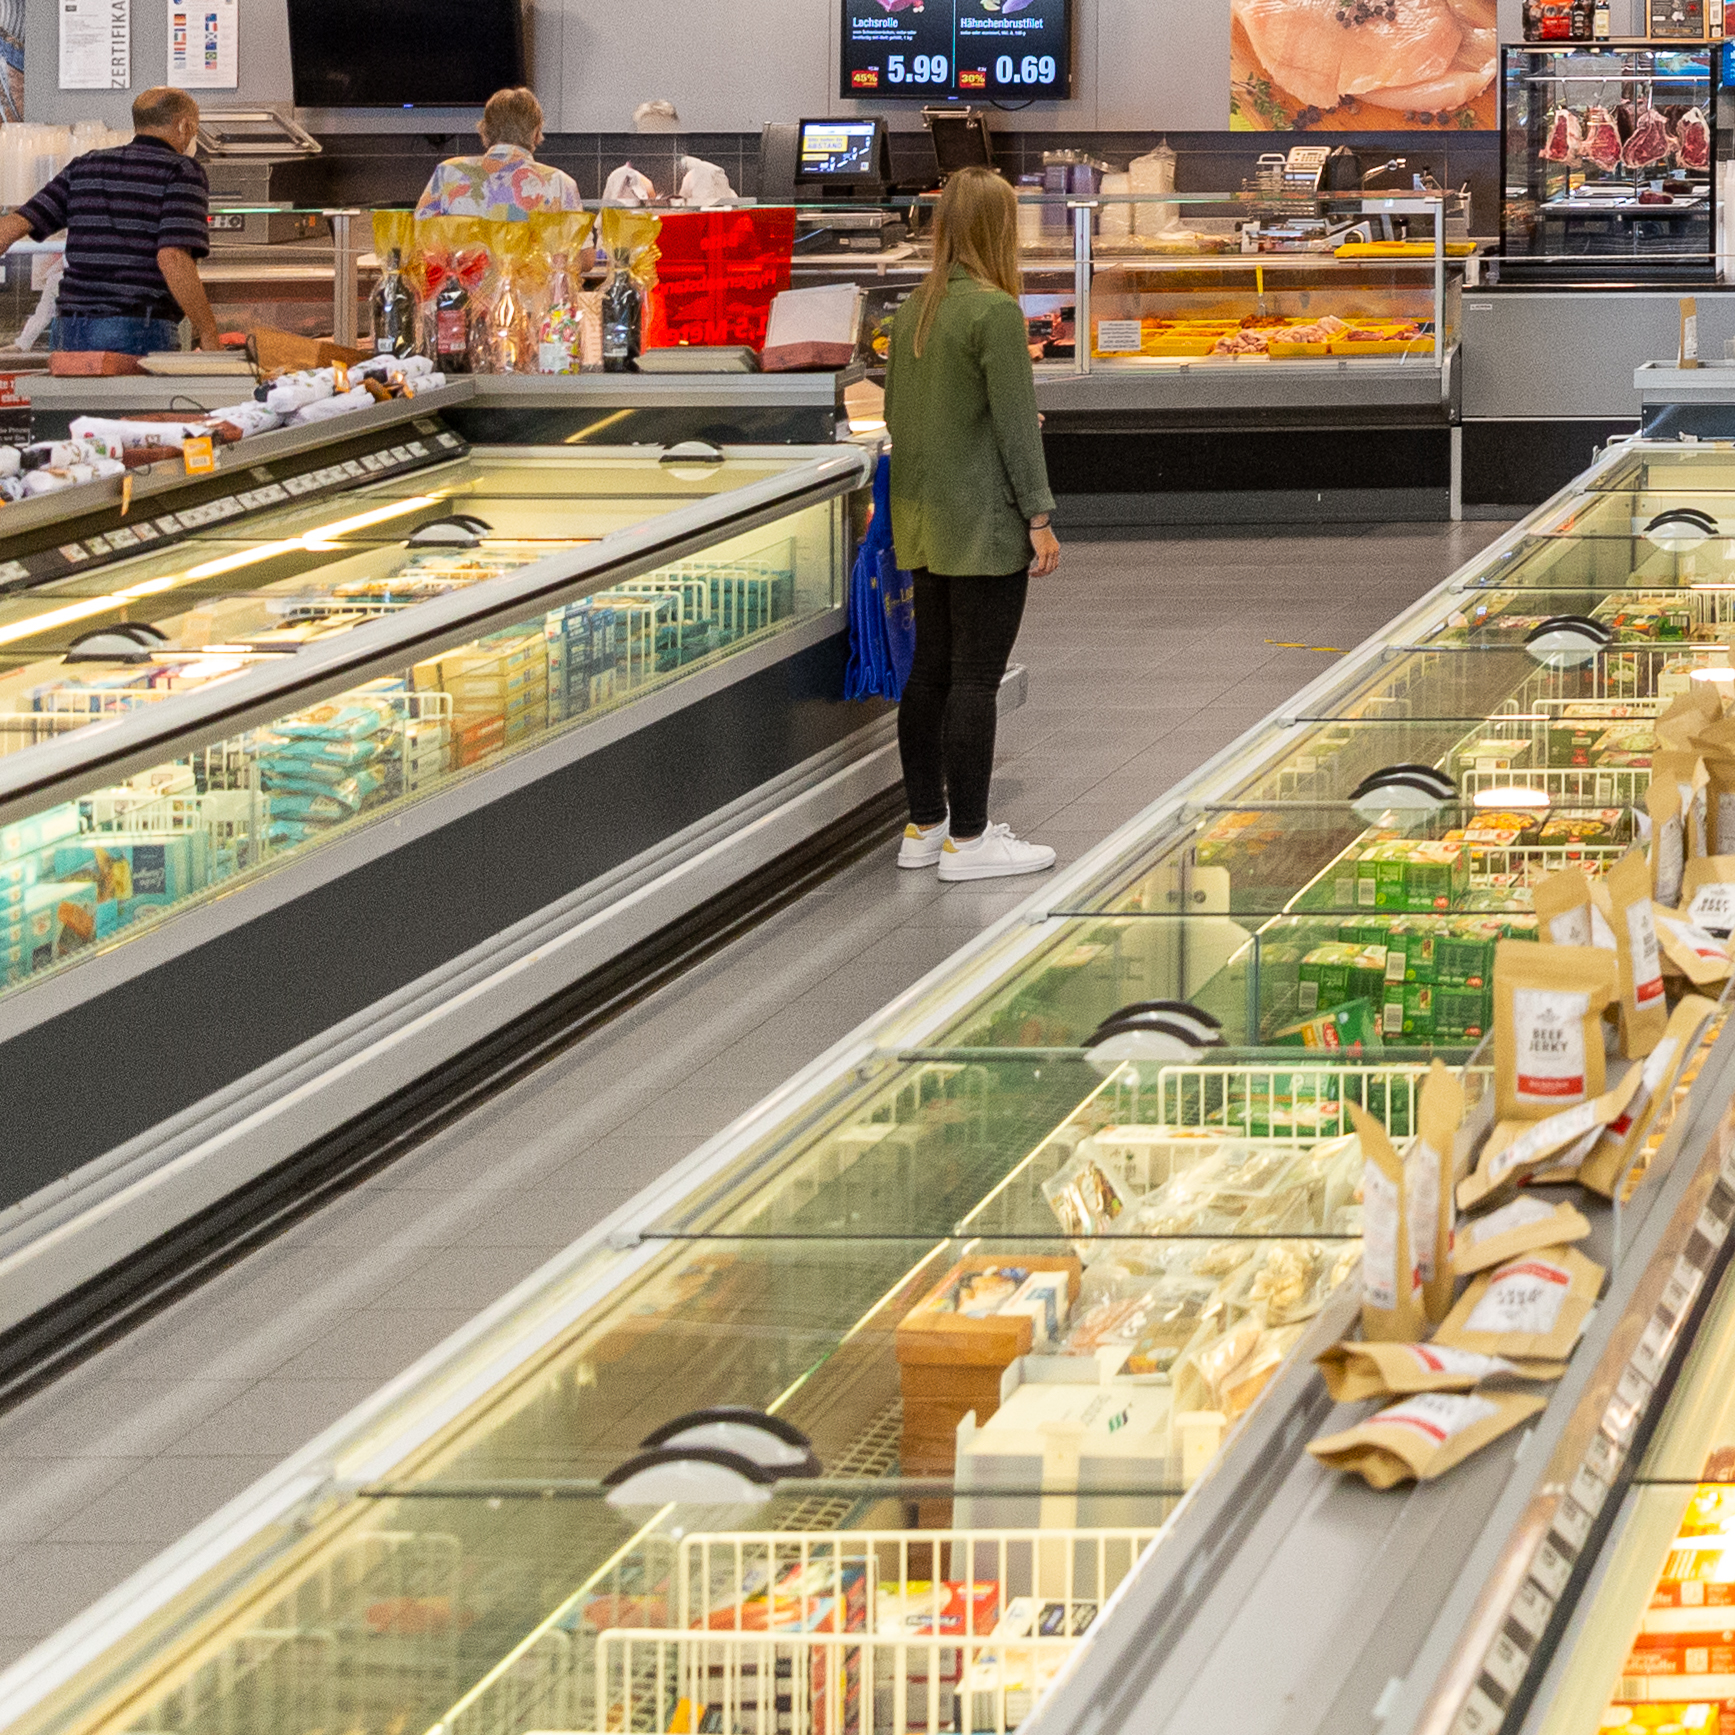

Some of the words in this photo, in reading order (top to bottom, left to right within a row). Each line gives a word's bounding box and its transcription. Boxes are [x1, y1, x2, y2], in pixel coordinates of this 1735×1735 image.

[852, 17, 898, 28] Lachsrolle
[960, 17, 1043, 29] Hähnchenbrustfilet
[888, 55, 948, 83] 5.99
[996, 55, 1056, 84] 0.69
[853, 73, 878, 83] 45%
[960, 73, 985, 84] 30%
[1702, 897, 1730, 907] BEEF
[1696, 904, 1730, 914] JERKY
[1532, 1027, 1564, 1041] BEEF
[1529, 1040, 1568, 1053] JERKY
